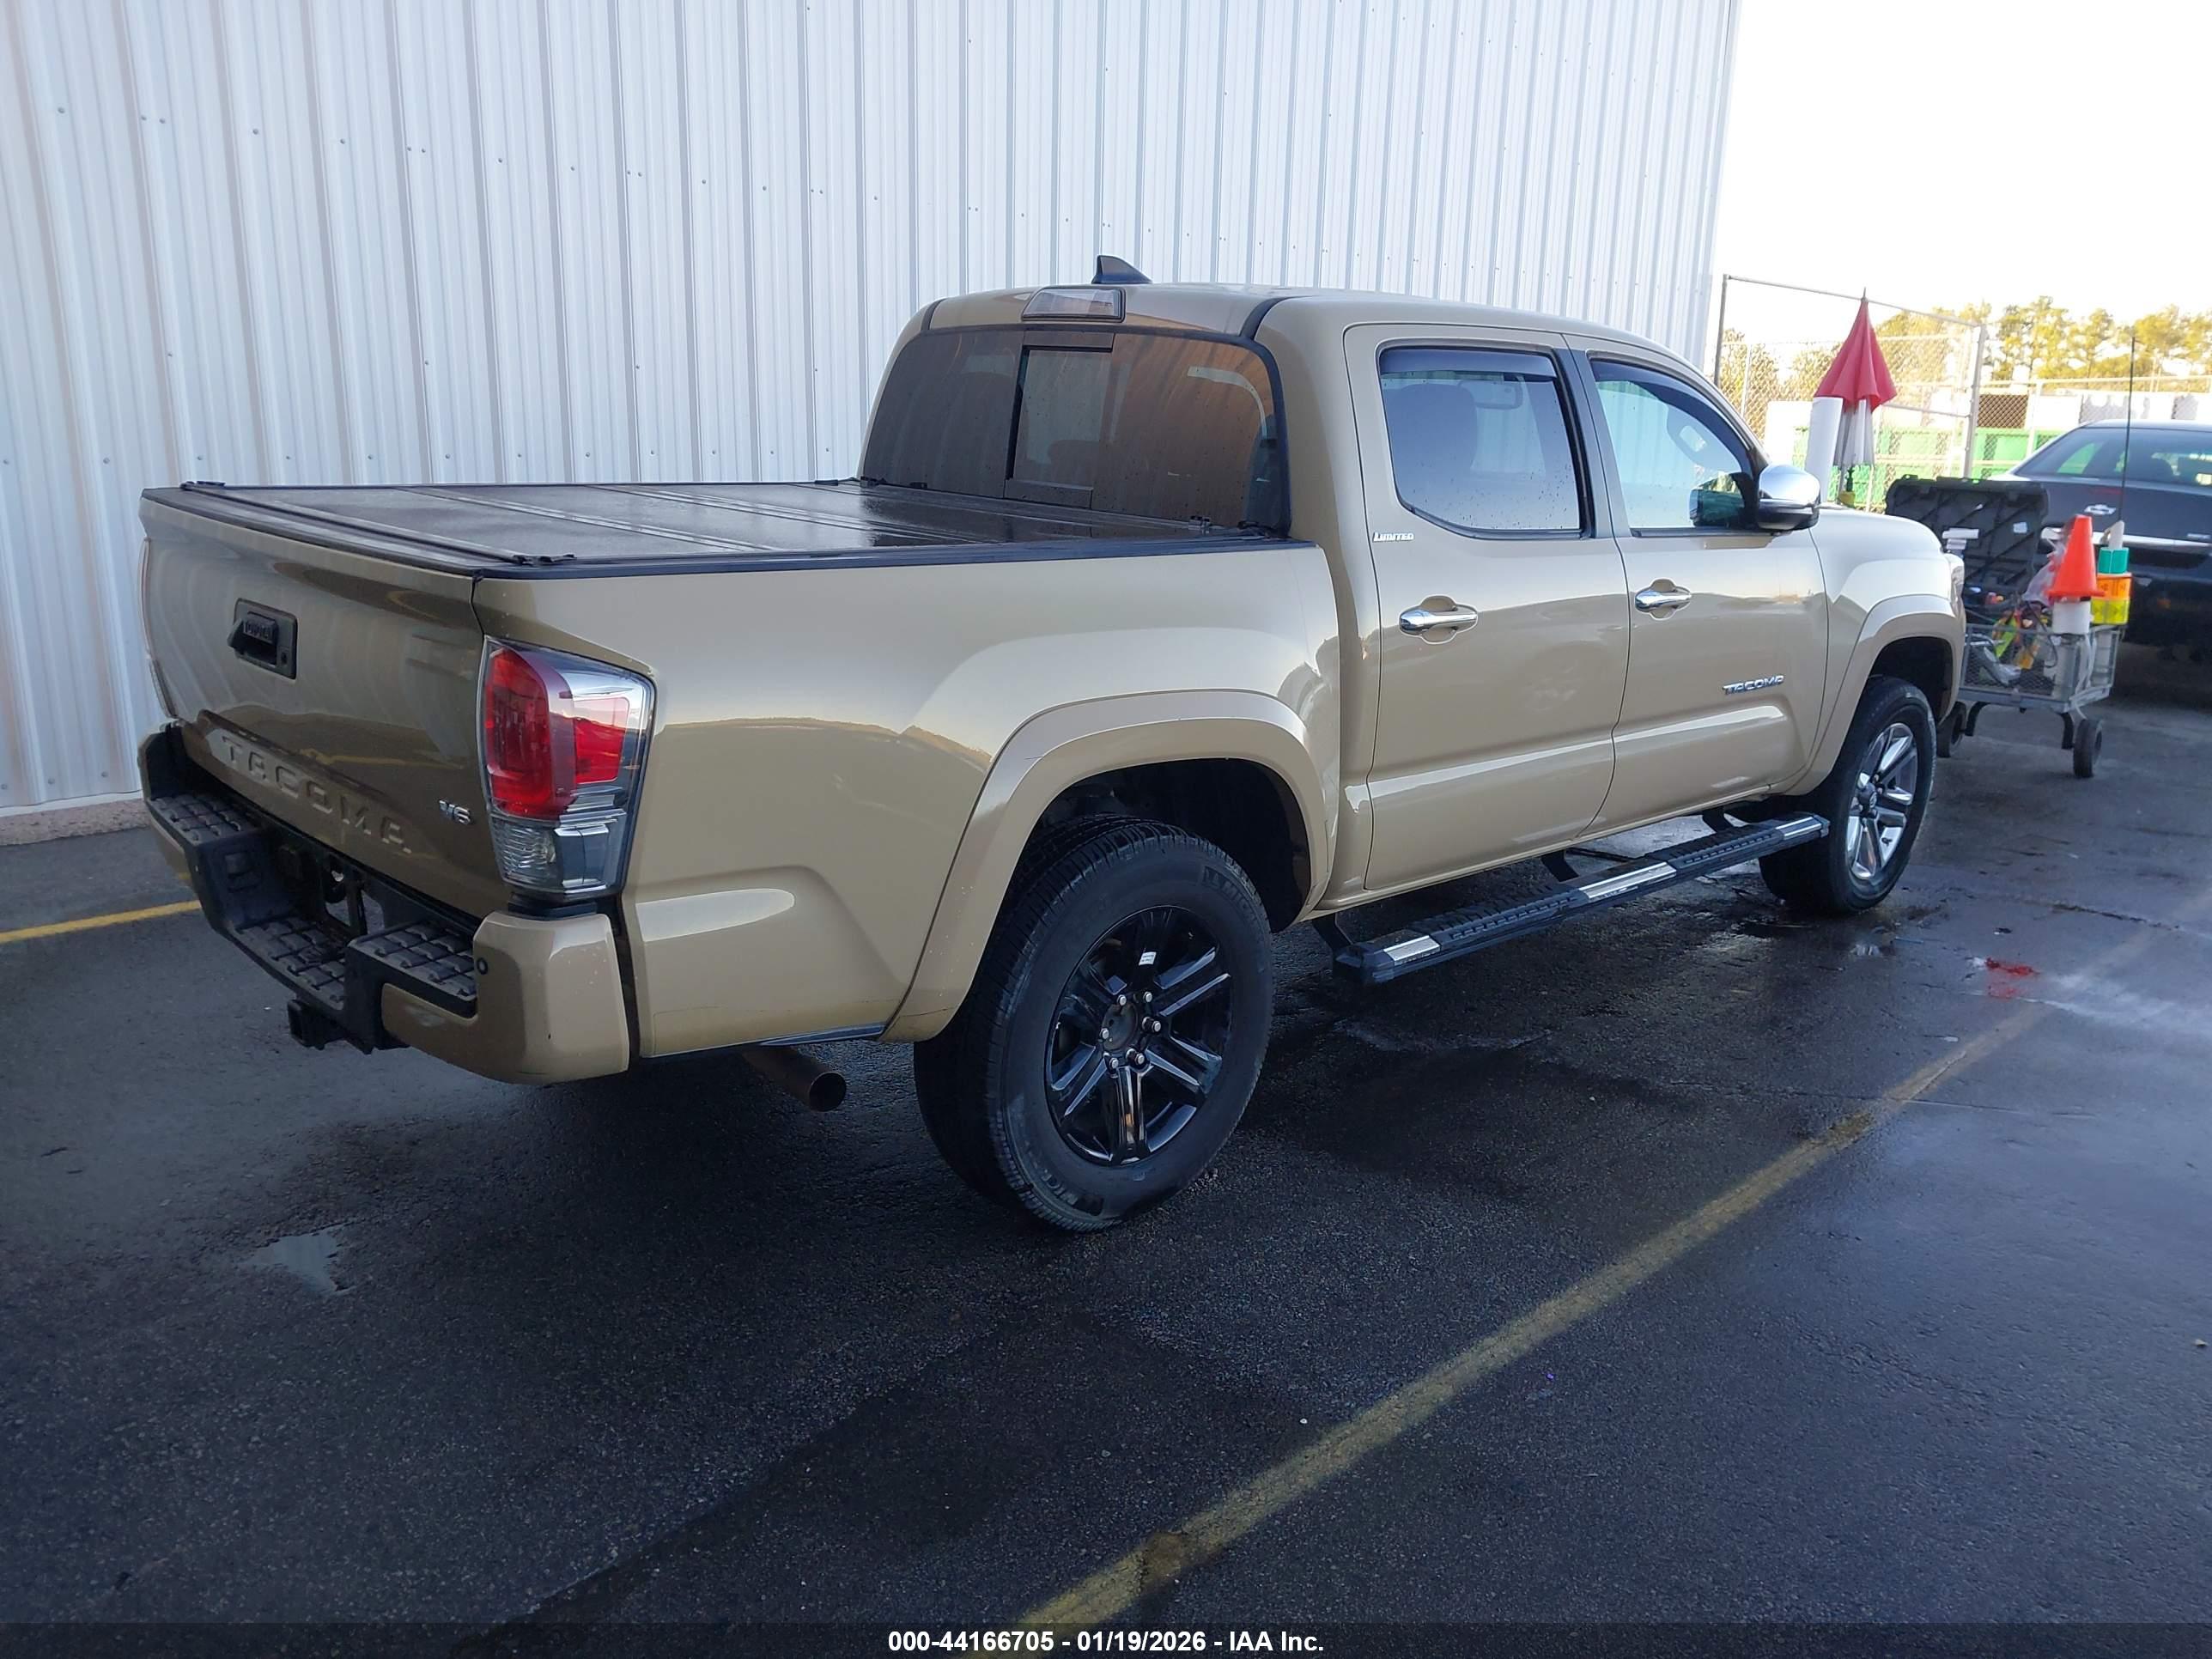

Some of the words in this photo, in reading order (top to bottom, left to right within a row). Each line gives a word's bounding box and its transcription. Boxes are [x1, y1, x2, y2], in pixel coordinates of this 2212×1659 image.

[1722, 675, 1785, 695] TACOMA
[222, 735, 412, 854] TACOMA
[439, 799, 471, 824] V6
